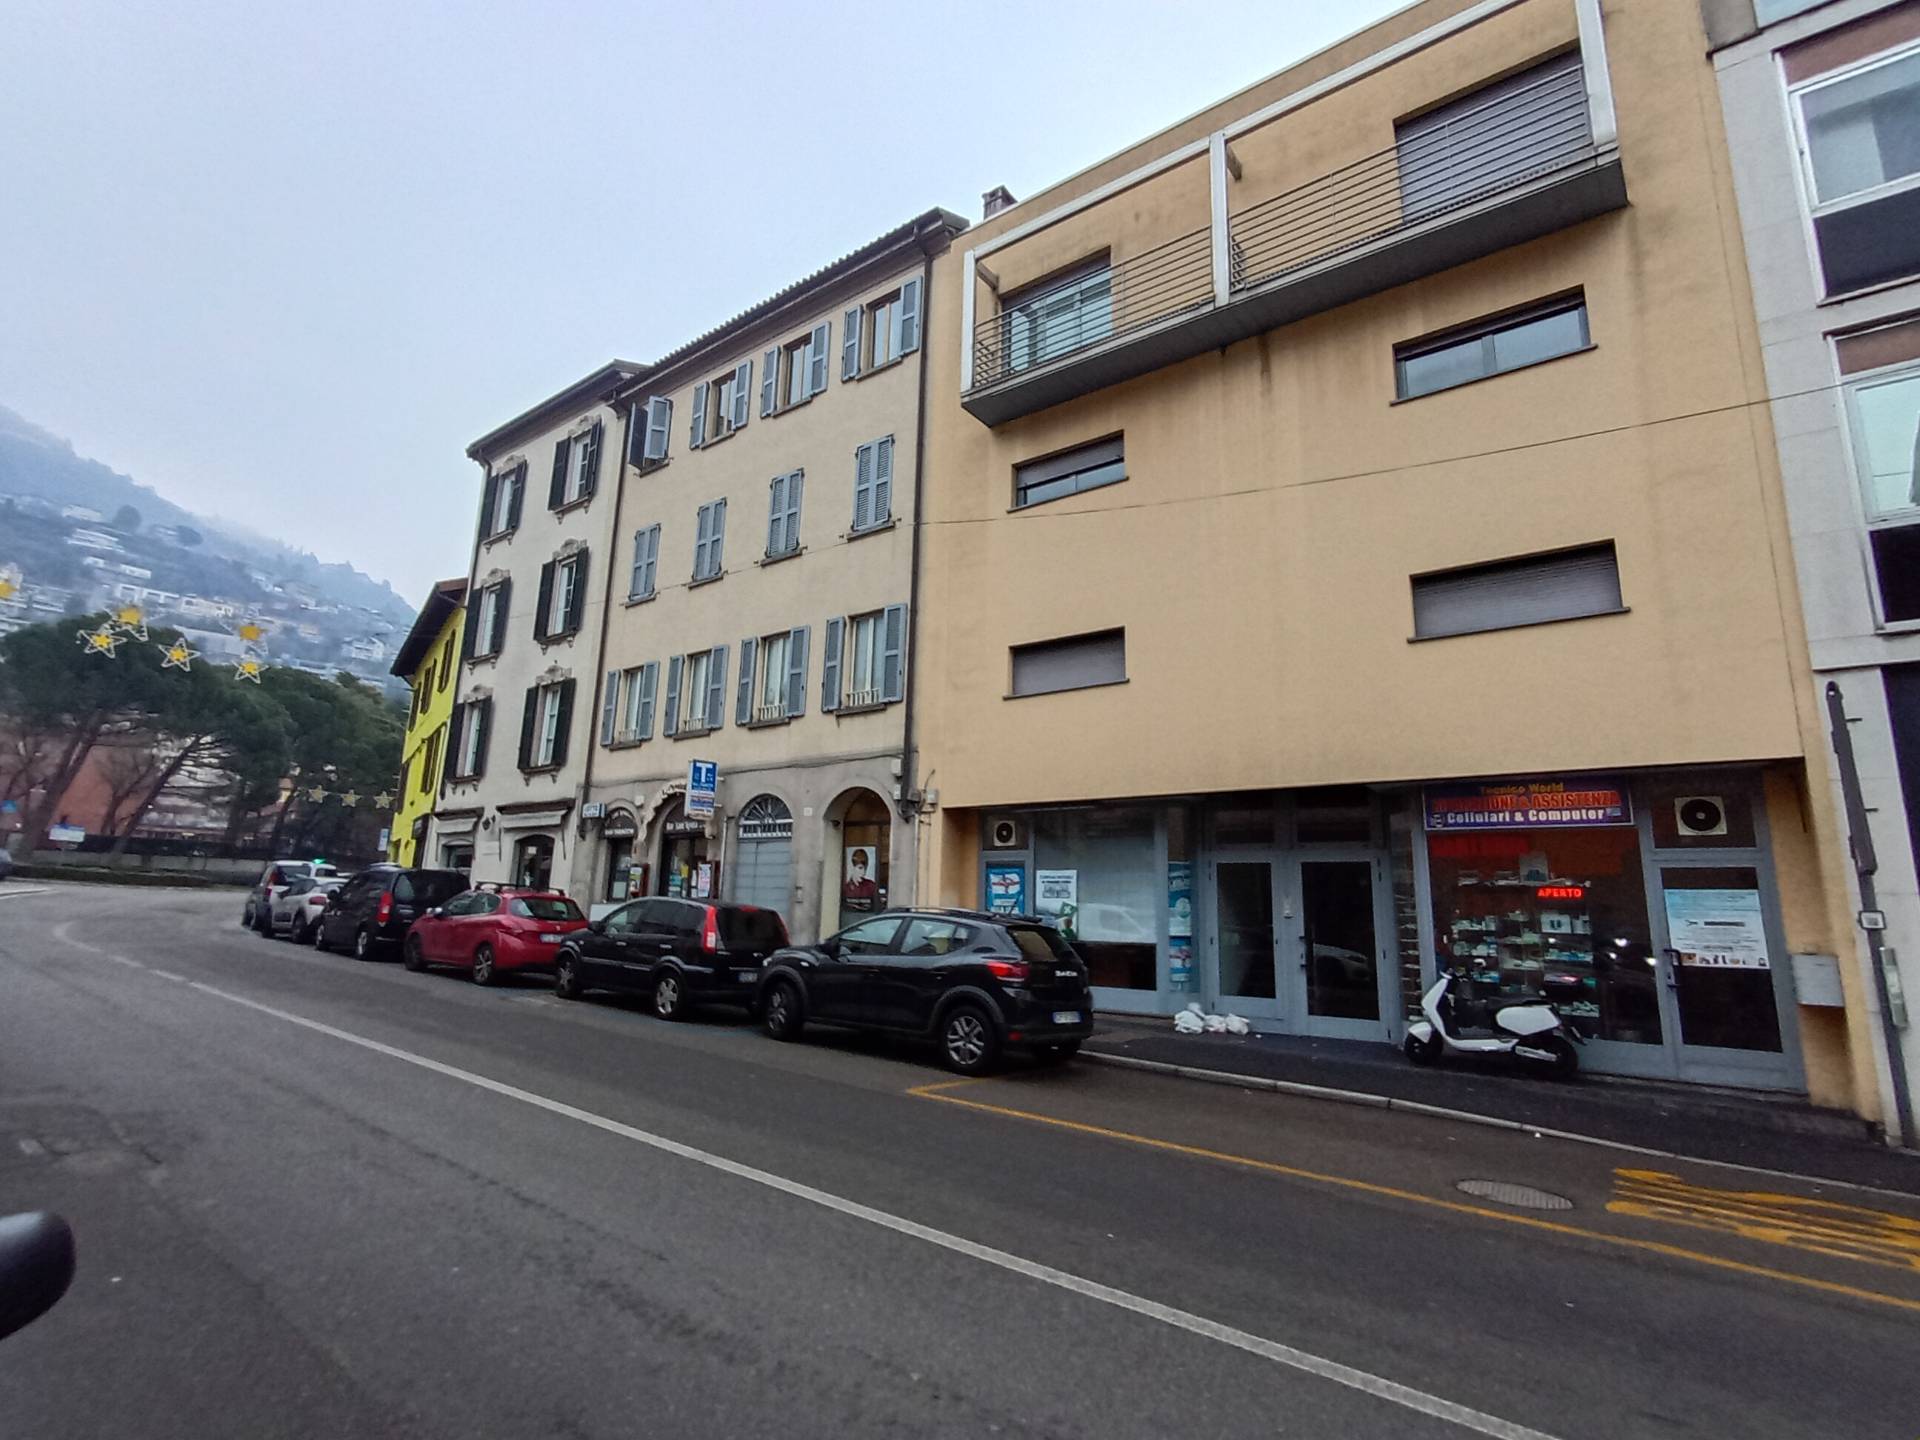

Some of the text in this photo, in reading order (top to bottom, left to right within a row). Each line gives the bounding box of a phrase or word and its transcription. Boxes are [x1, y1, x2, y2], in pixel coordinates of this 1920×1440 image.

[695, 762, 713, 783] T
[1528, 782, 1564, 793] World
[1447, 807, 1606, 824] Cellulari & Computer
[1537, 887, 1582, 898] APERTO
